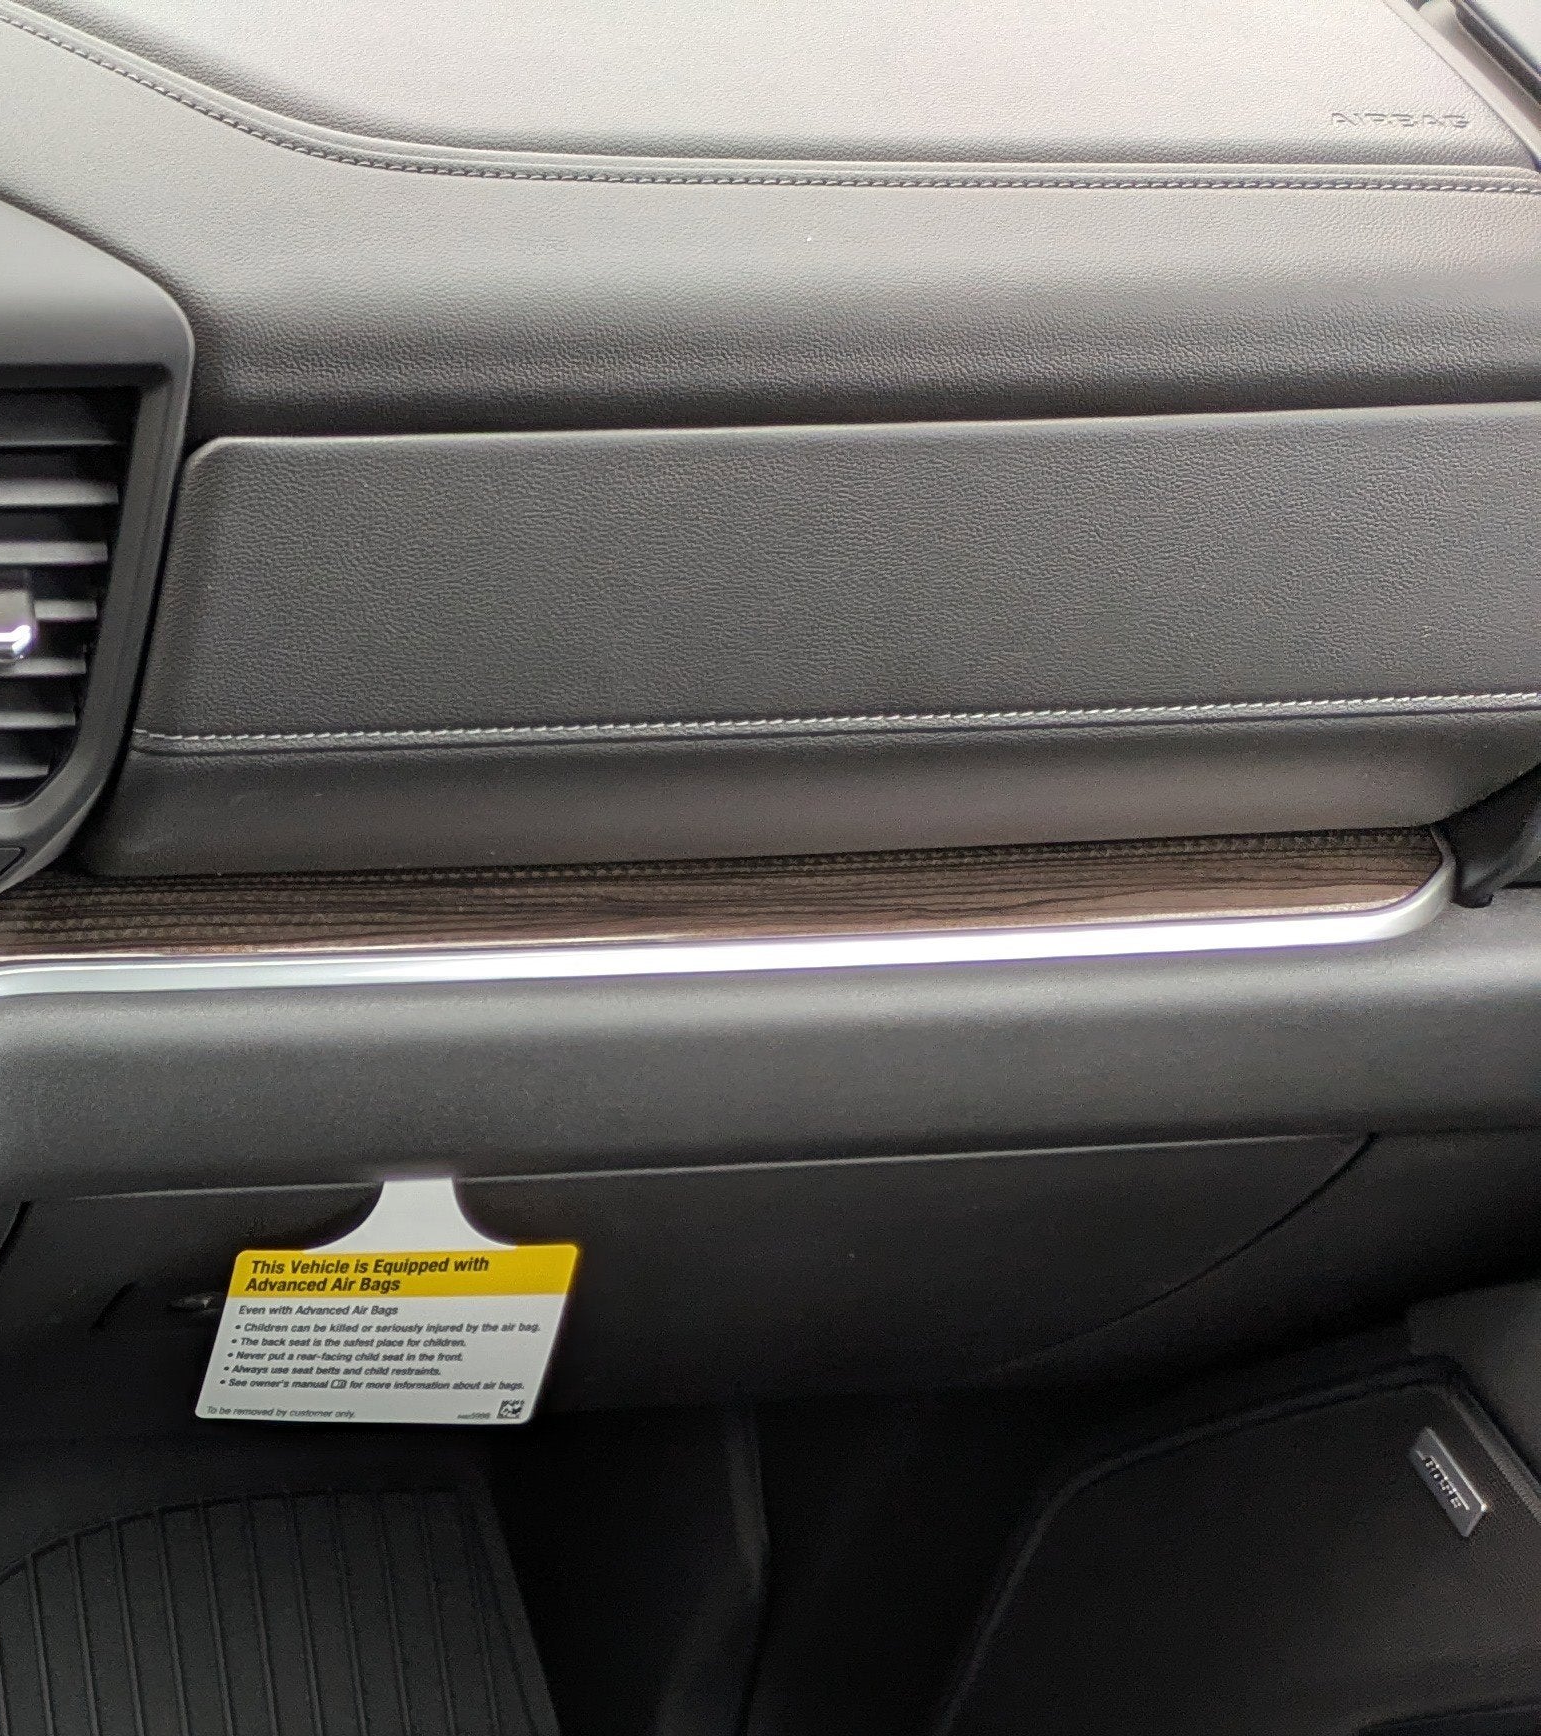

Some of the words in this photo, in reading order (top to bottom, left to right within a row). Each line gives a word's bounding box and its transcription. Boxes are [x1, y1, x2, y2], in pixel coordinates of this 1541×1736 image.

[251, 1259, 285, 1275] This
[291, 1259, 350, 1275] Vehicle
[353, 1259, 369, 1274] is
[373, 1257, 450, 1276] Equipped
[453, 1256, 490, 1272] with
[245, 1277, 328, 1292] Advanced
[330, 1276, 355, 1292] Air
[358, 1277, 401, 1294] Bags
[238, 1305, 266, 1315] Even
[269, 1305, 293, 1315] with
[294, 1305, 350, 1315] Advanced
[351, 1305, 369, 1315] Air
[370, 1305, 399, 1317] Bags
[243, 1323, 288, 1332] Children
[291, 1324, 310, 1332] can
[313, 1323, 327, 1332] be
[329, 1323, 359, 1333] killed
[361, 1325, 373, 1333] or
[375, 1322, 423, 1334] seriously
[425, 1322, 464, 1334] injured
[465, 1323, 479, 1334] by
[481, 1323, 498, 1332] the
[501, 1323, 515, 1332] air
[518, 1322, 541, 1333] bag.
[240, 1337, 259, 1346] The
[261, 1338, 286, 1346] back
[288, 1338, 311, 1347] seat
[324, 1338, 341, 1347] the
[343, 1338, 375, 1347] safest
[376, 1338, 404, 1348] place
[406, 1338, 421, 1347] for
[422, 1338, 467, 1348] children.
[235, 1351, 266, 1360] Never
[267, 1352, 286, 1362] put
[287, 1353, 295, 1361] a
[296, 1351, 352, 1363] rear-facing
[354, 1353, 379, 1362] child
[382, 1353, 405, 1362] seat
[406, 1352, 416, 1362] in
[418, 1353, 435, 1362] the
[437, 1353, 464, 1362] front.
[231, 1364, 268, 1375] Always
[270, 1366, 289, 1374] use
[291, 1366, 314, 1375] seat
[342, 1366, 362, 1375] and
[364, 1367, 390, 1376] child
[391, 1367, 441, 1376] restraints.
[228, 1378, 247, 1387] See
[249, 1379, 290, 1388] owner's
[291, 1379, 329, 1389] manual
[349, 1380, 363, 1389] for
[365, 1381, 391, 1389] more
[393, 1380, 450, 1390] information
[452, 1380, 482, 1390] about
[483, 1381, 497, 1390] air
[498, 1381, 525, 1391] bags.
[206, 1406, 217, 1415] To
[219, 1406, 232, 1415] be
[233, 1406, 274, 1416] removed
[275, 1408, 287, 1418] by
[289, 1408, 333, 1417] customer
